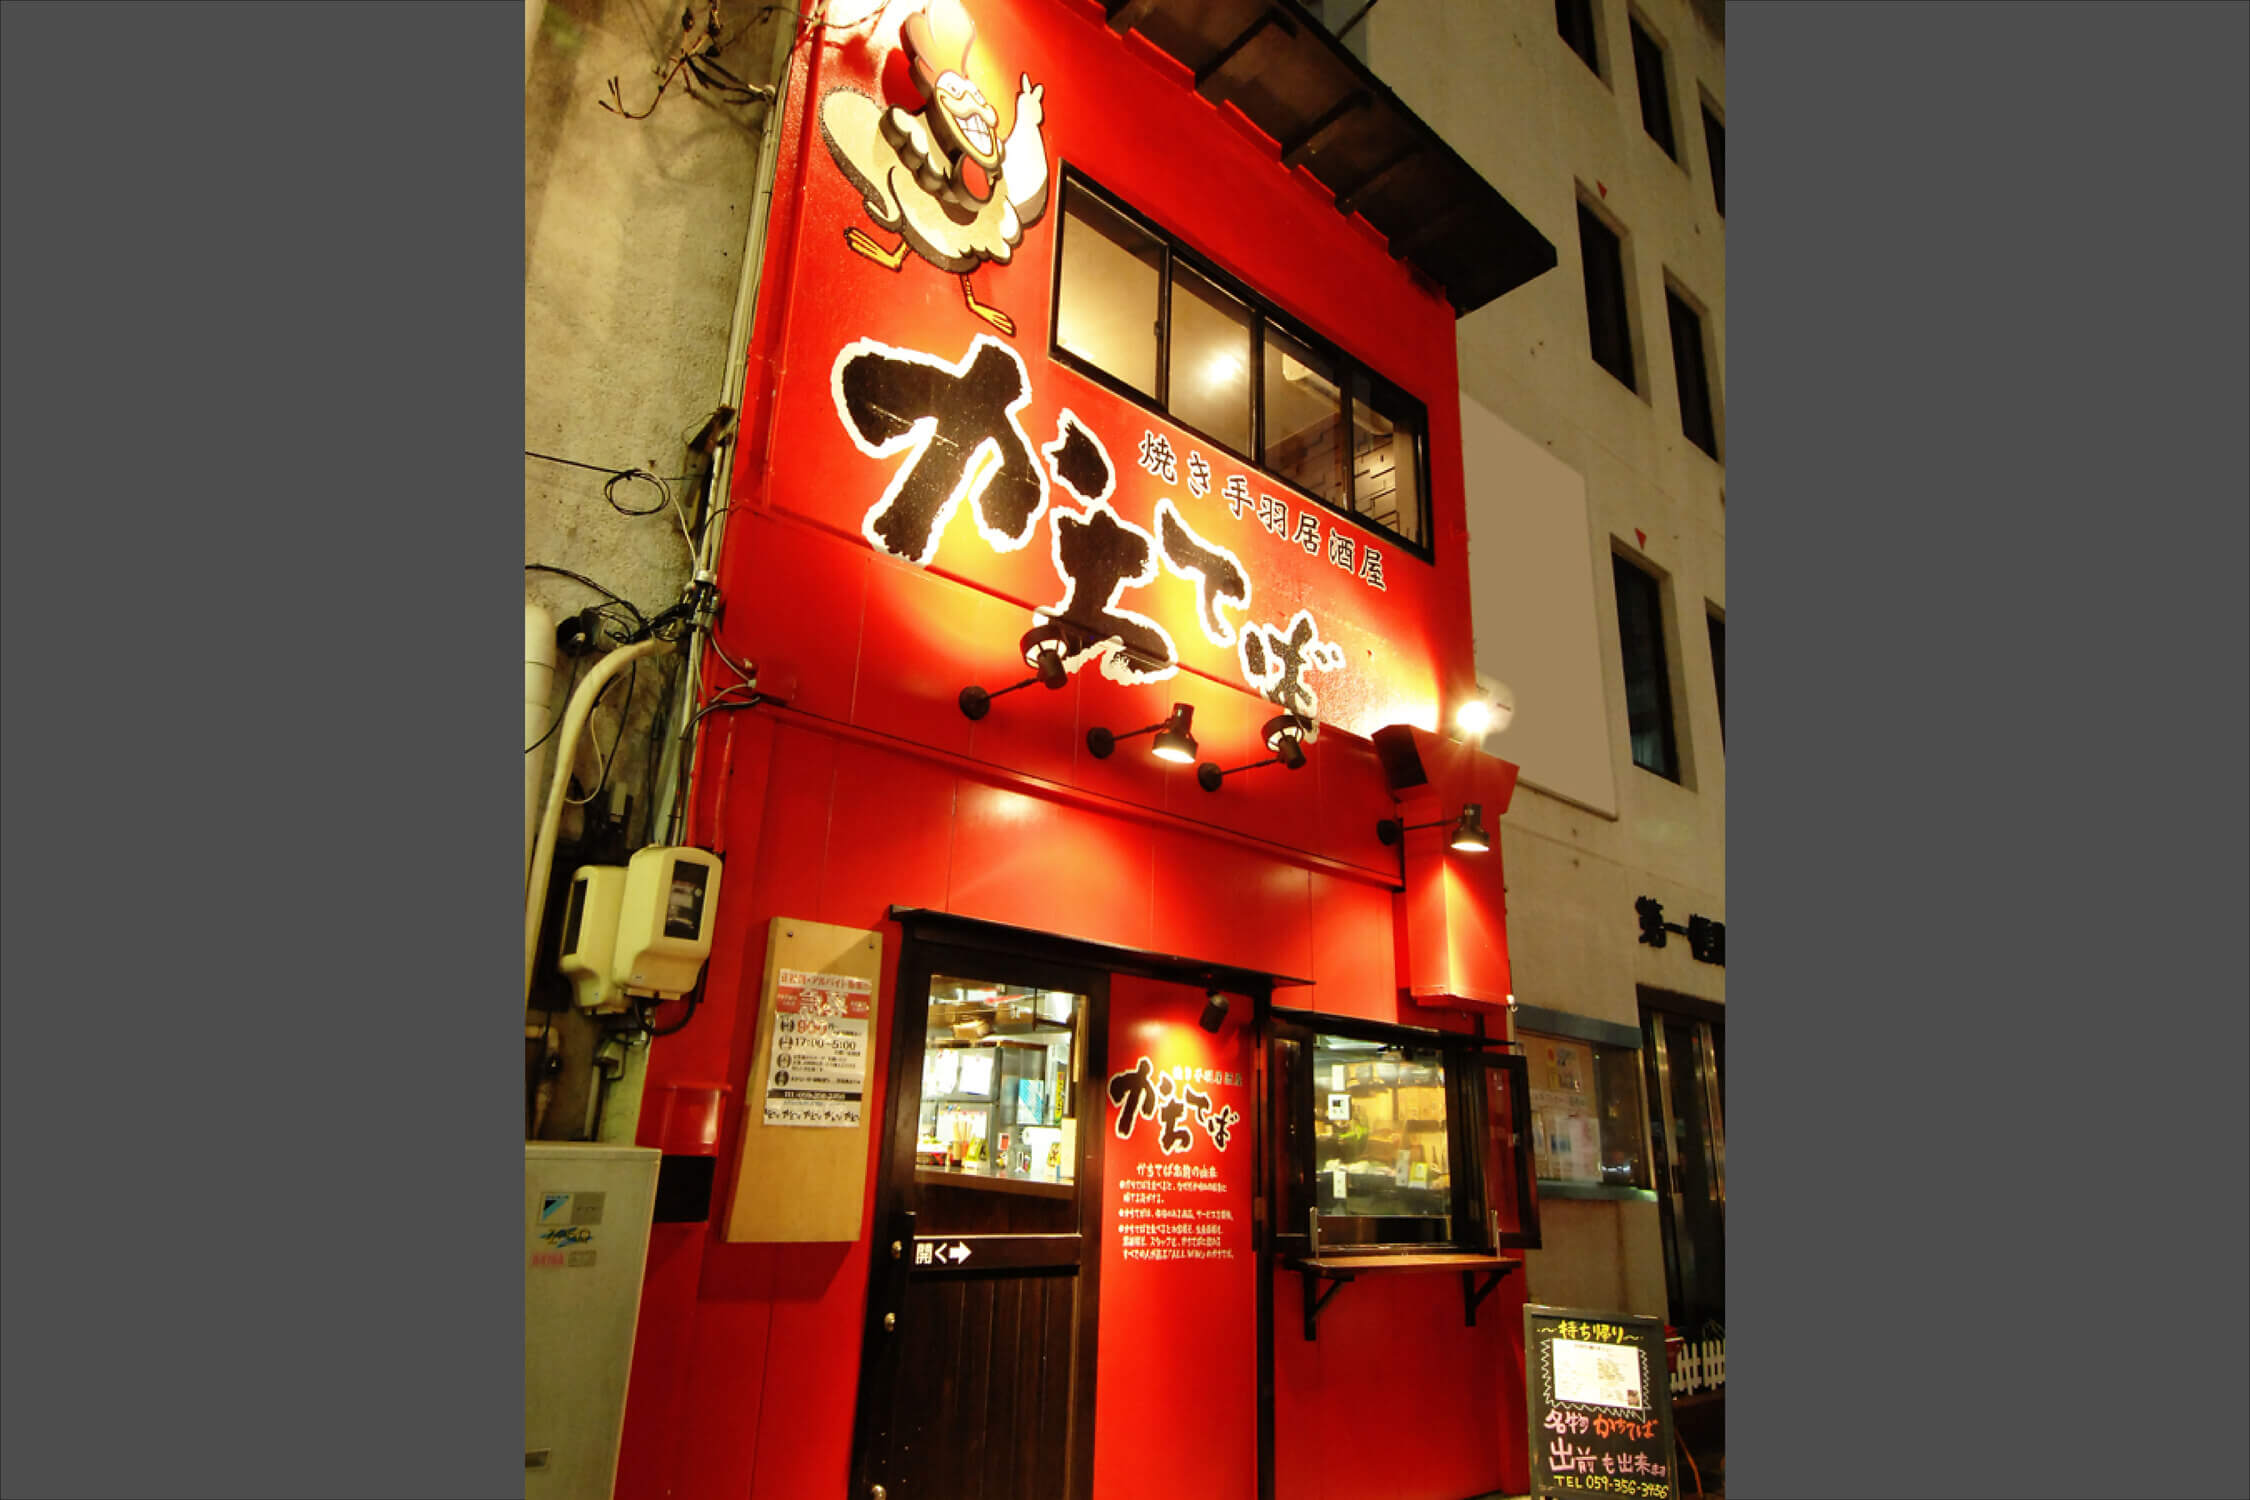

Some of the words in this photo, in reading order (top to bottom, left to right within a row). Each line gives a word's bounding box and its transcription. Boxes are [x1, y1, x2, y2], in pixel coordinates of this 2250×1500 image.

[1138, 430, 1388, 592] 焼き手羽居酒屋
[1107, 1056, 1241, 1156] かちてば
[916, 1243, 947, 1264] 開く
[1544, 1409, 1589, 1434] 名物
[1553, 1475, 1583, 1489] TEL
